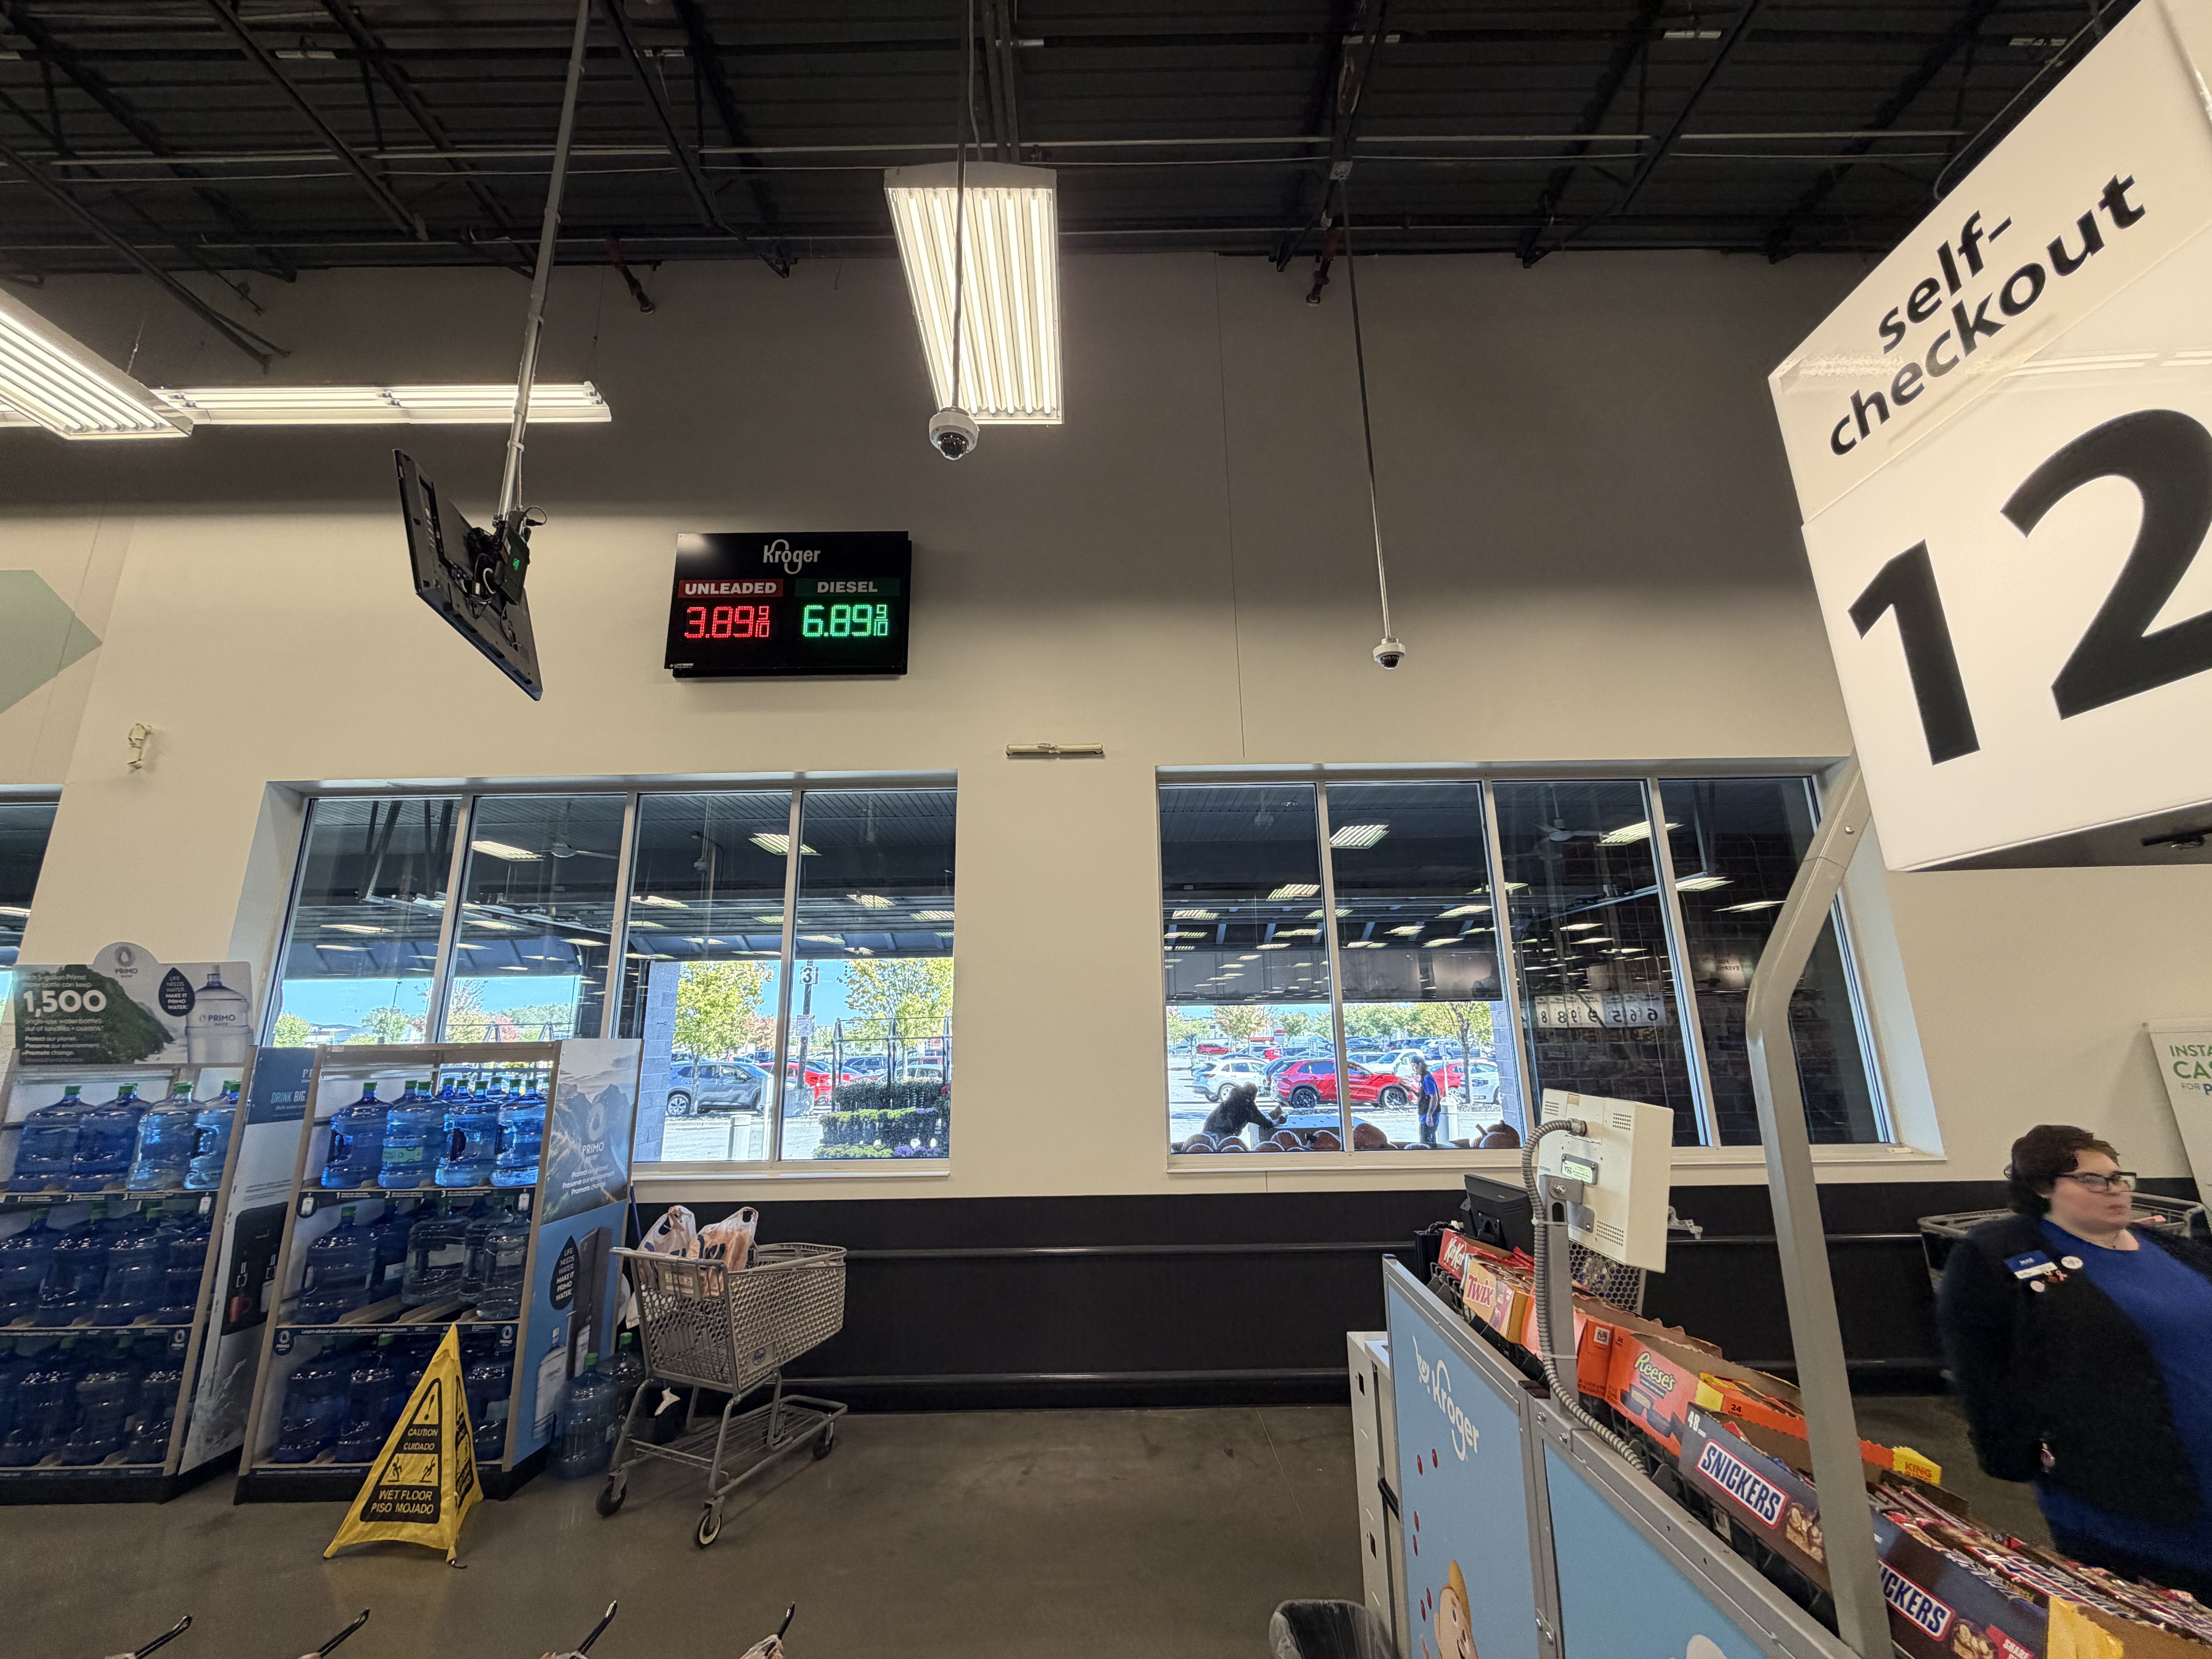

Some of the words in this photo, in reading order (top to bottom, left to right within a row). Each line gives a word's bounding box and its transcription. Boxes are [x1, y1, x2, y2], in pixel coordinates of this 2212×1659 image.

[1879, 210, 2012, 353] self-
[1831, 173, 2146, 455] checkout
[763, 539, 821, 574] Kroger
[685, 582, 776, 595] UNLEADED
[817, 582, 878, 593] DIESEL
[1847, 409, 2212, 766] 12
[803, 967, 812, 983] 3
[23, 990, 106, 1017] 1,500
[2173, 1061, 2212, 1079] CA
[271, 1091, 293, 1103] DRINK
[582, 1142, 604, 1154] PRIMO
[564, 1247, 574, 1256] LIFE
[560, 1255, 575, 1266] NEEDS
[556, 1273, 570, 1284] MAKE
[556, 1281, 572, 1292] PRIMO
[1432, 1360, 1479, 1461] Kroger
[1731, 1404, 1741, 1413] 24
[1688, 1410, 1700, 1432] 48
[407, 1428, 438, 1436] CAUTION
[404, 1442, 435, 1451] CUIDADO
[1905, 1461, 1932, 1478] KING
[1700, 1444, 1781, 1522] SNICKERS
[378, 1489, 402, 1500] WET
[400, 1490, 433, 1501] FLOOR
[371, 1502, 392, 1513] PISO
[395, 1503, 434, 1515] MOJADO
